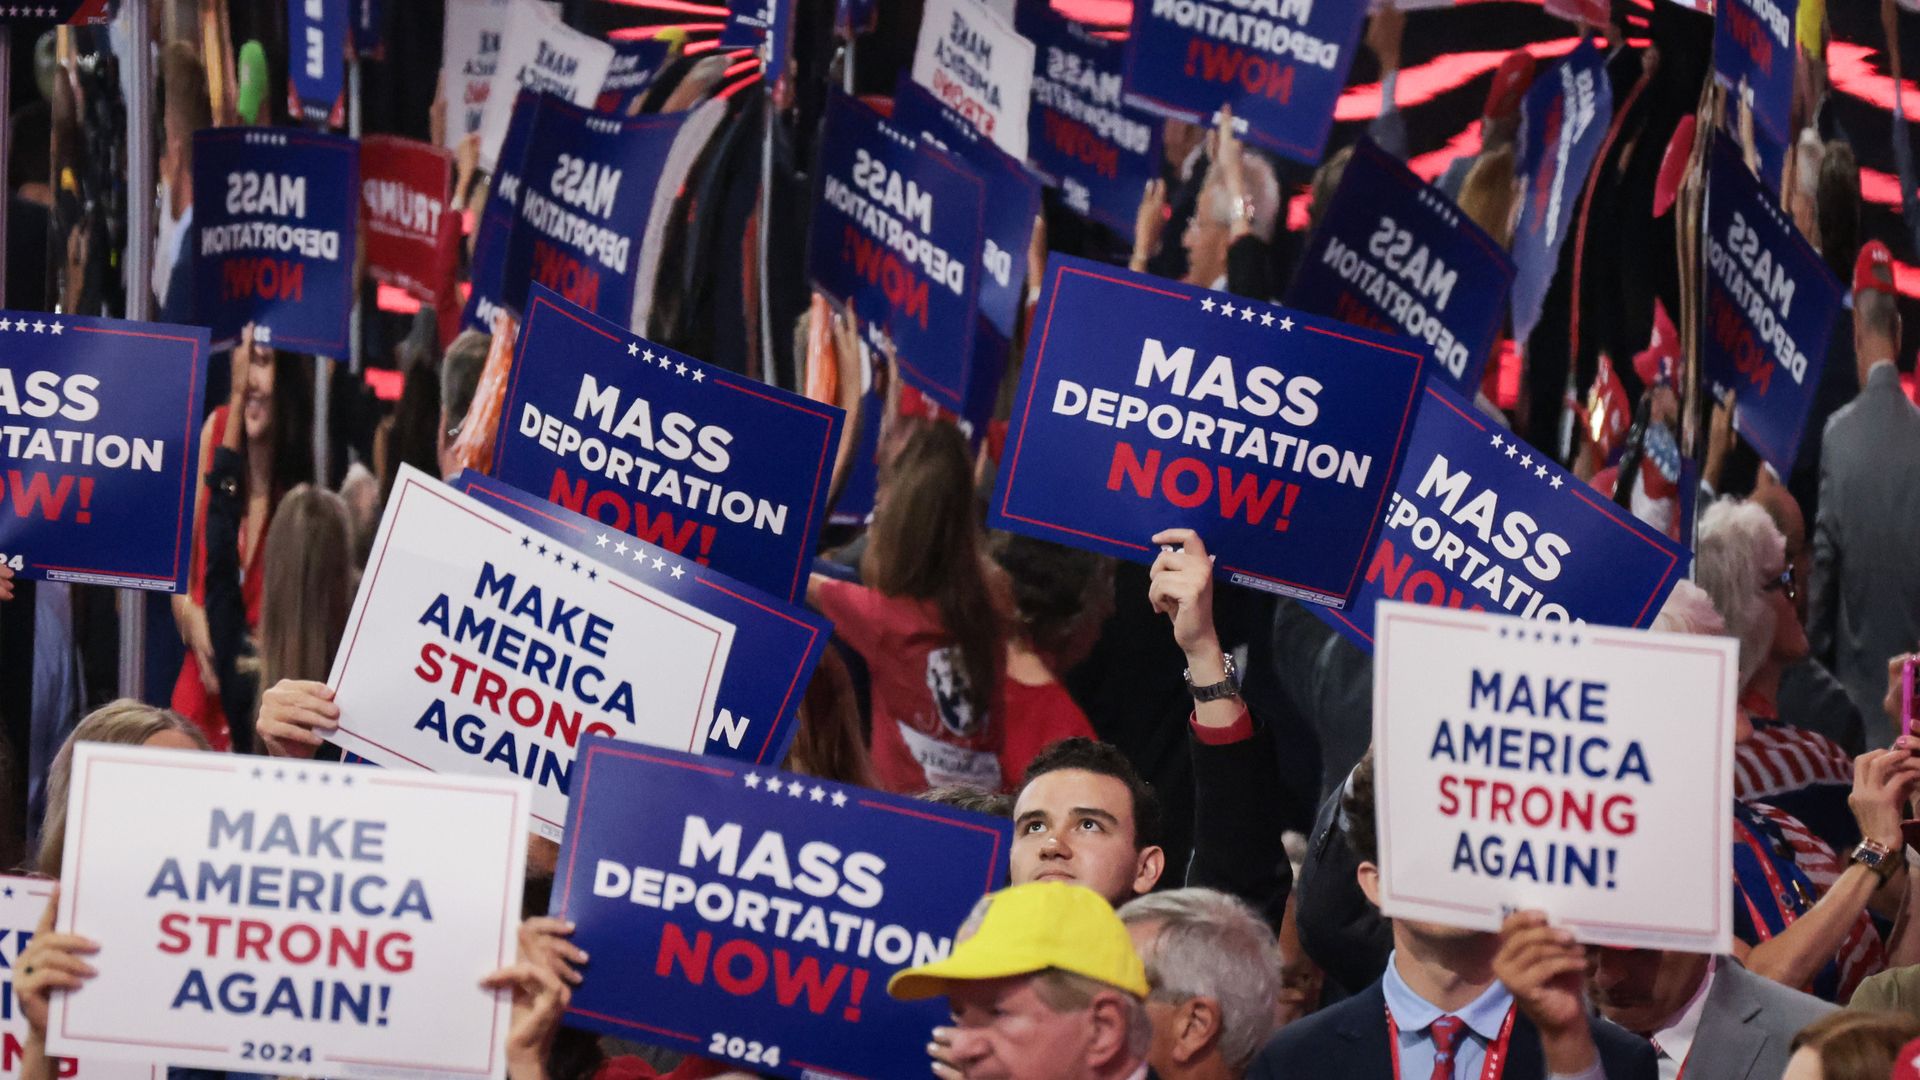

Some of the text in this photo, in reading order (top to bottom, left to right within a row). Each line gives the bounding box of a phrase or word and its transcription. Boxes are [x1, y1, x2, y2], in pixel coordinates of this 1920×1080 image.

[572, 373, 734, 473] MASS
[1135, 338, 1323, 426] MASS
[519, 402, 788, 536] DEPORTATION
[1052, 379, 1372, 488] DEPORTATION
[548, 467, 717, 568] NOW!
[1107, 441, 1301, 532] NOW!
[1416, 453, 1571, 582] MASS
[473, 561, 615, 659] MAKE
[419, 592, 636, 725] AMERICA
[1469, 668, 1608, 724] MAKE
[414, 698, 573, 797] AGAIN
[1429, 720, 1652, 784] AMERICA
[207, 808, 387, 862] MAKE
[1437, 775, 1638, 836] STRONG
[146, 858, 433, 921] AMERICA
[678, 815, 886, 909] MASS
[1451, 832, 1618, 889] AGAIN!
[157, 913, 414, 973] STRONG
[593, 859, 953, 968] DEPORTATION
[171, 969, 391, 1027] AGAIN!
[656, 922, 870, 1023] NOW!
[241, 1042, 313, 1064] 2024
[708, 1032, 780, 1068] 2024
